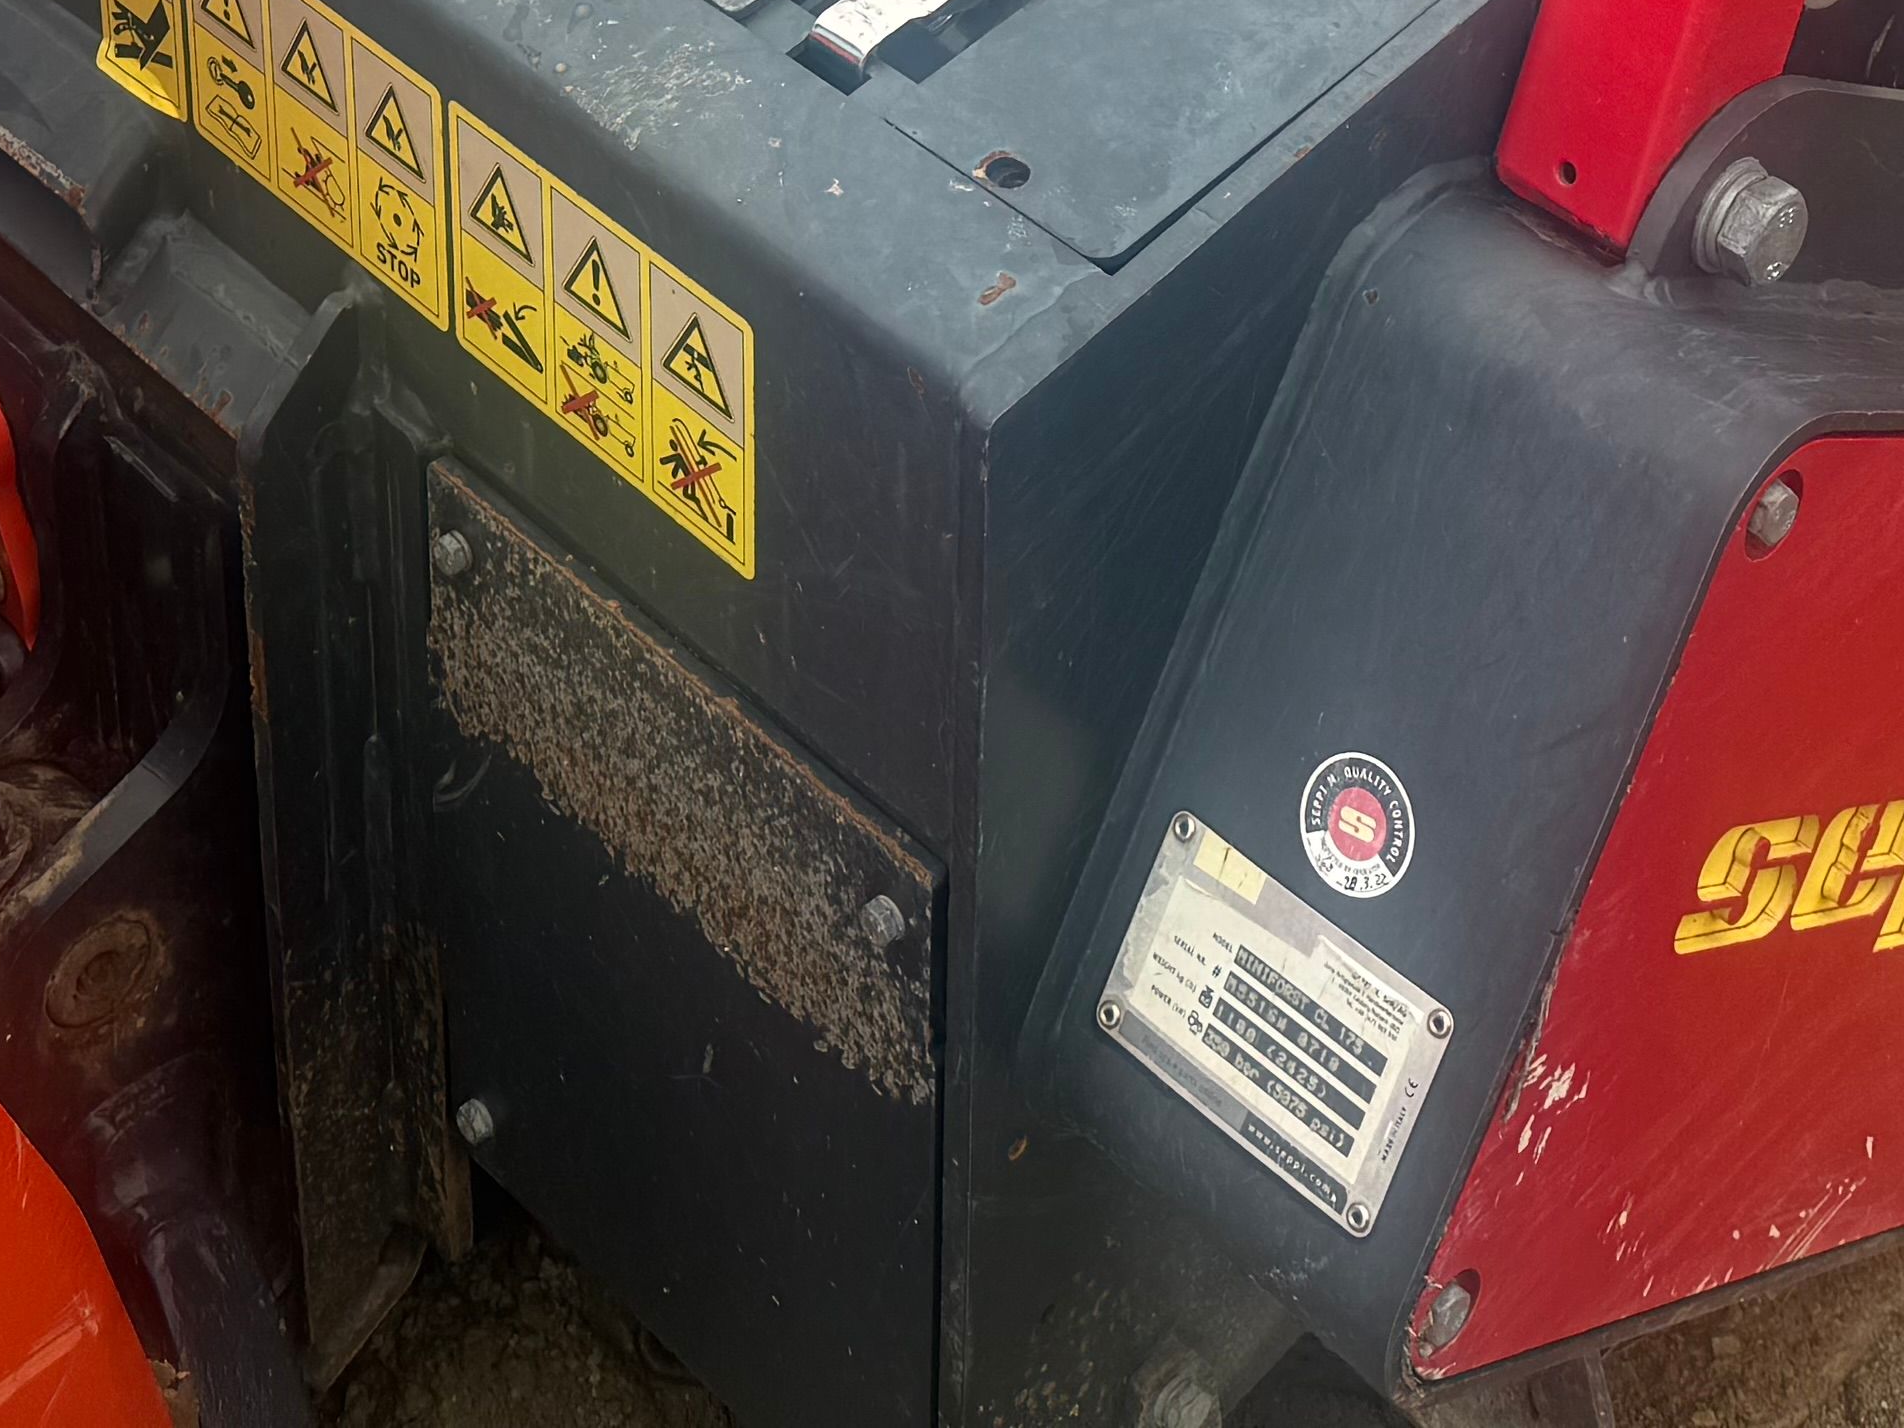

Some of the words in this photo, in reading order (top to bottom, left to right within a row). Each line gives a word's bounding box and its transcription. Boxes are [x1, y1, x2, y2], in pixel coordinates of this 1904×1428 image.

[376, 242, 421, 288] STOP
[1343, 765, 1393, 796] QUALITY
[1386, 800, 1404, 864] CONTROL
[1235, 945, 1310, 1013] MINIFORST
[1312, 1005, 1334, 1031] CL
[1336, 1023, 1366, 1056] 175
[1246, 1119, 1332, 1198] www.seppi.com
